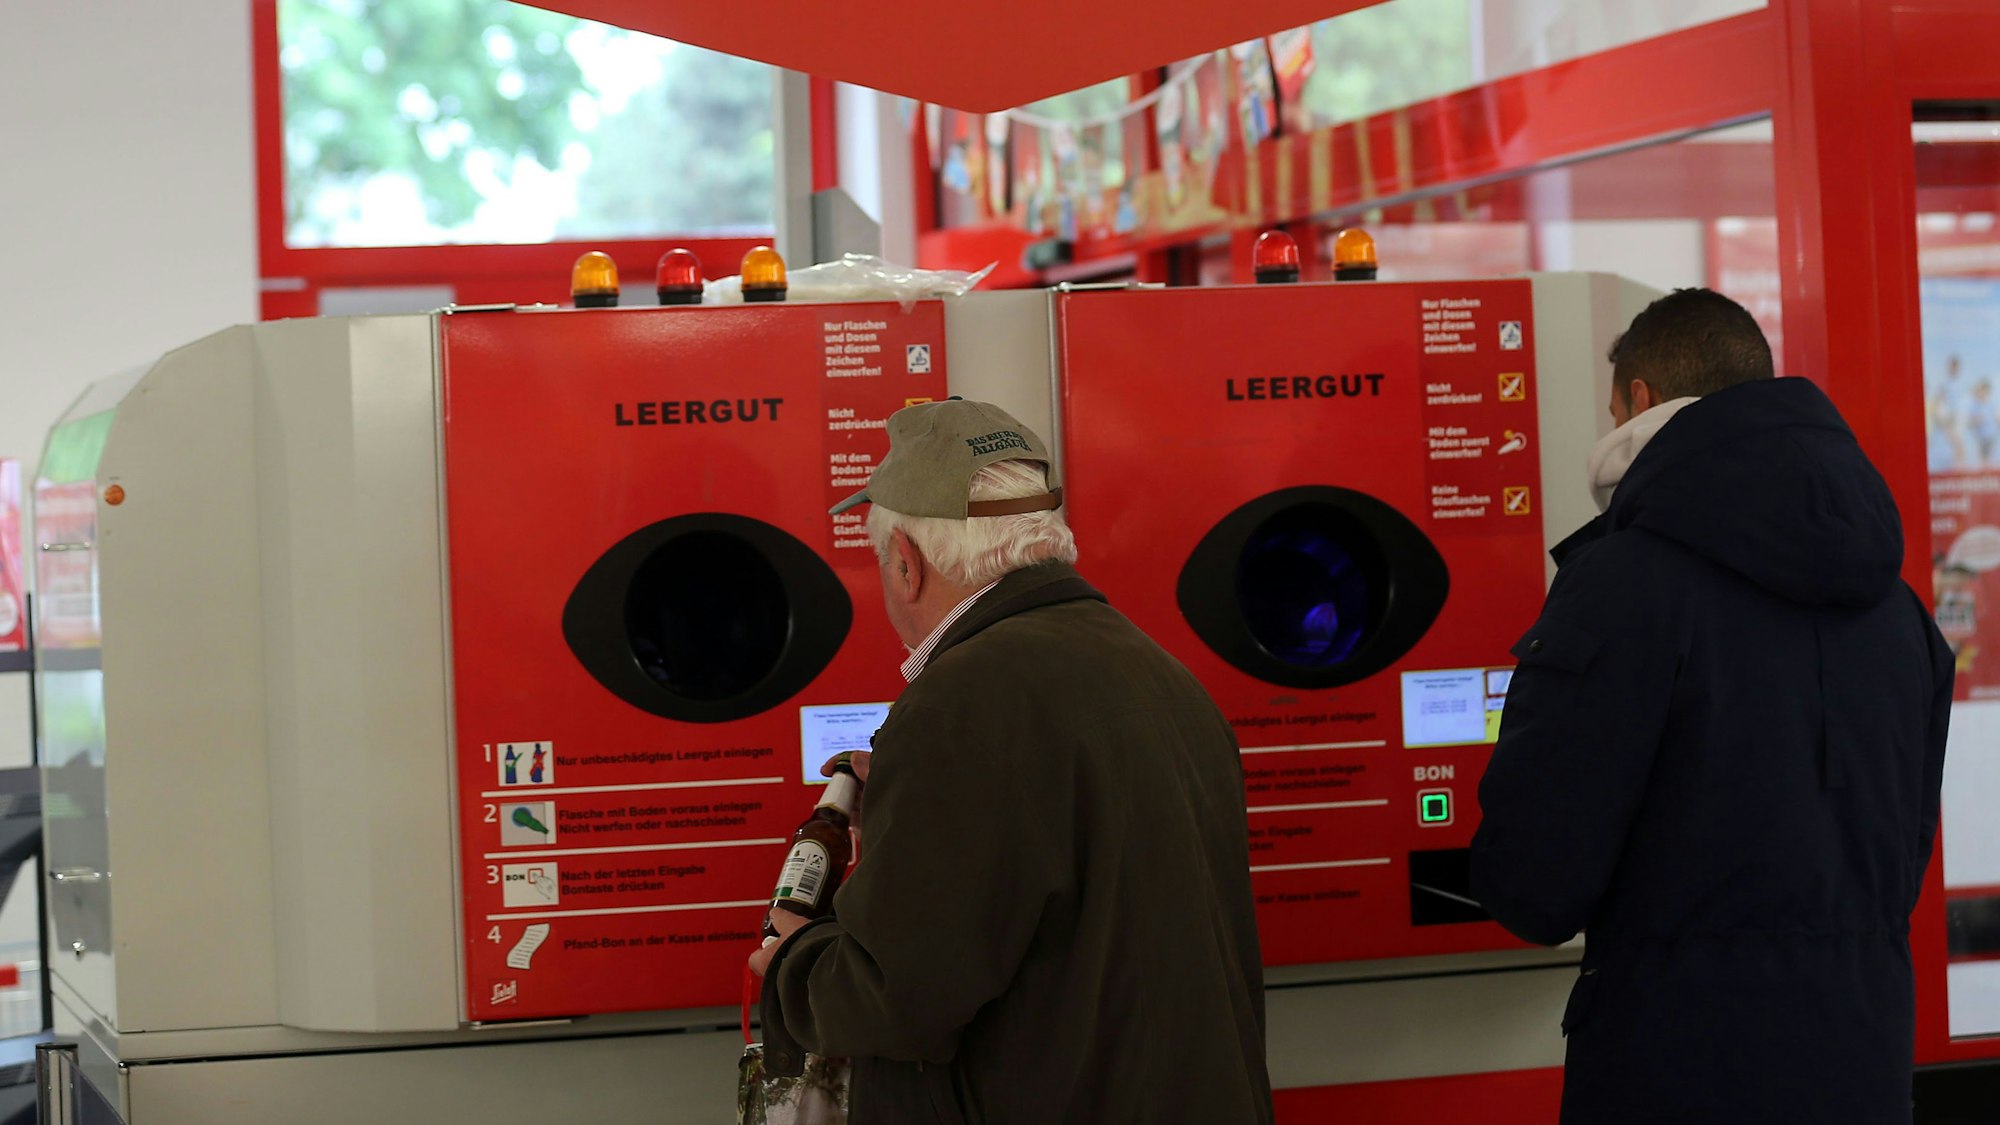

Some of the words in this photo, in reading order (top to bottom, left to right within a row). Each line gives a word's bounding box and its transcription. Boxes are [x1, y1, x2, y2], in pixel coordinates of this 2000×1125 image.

[1440, 298, 1481, 309] Flaschen
[824, 321, 843, 331] Nur
[844, 320, 887, 331] Flaschen
[825, 332, 844, 343] und
[846, 332, 877, 342] Dosen
[825, 344, 843, 354] mit
[844, 343, 881, 353] diesem
[826, 356, 865, 366] Zeichen
[826, 366, 882, 378] einwerfen!
[1227, 374, 1385, 401] LEERGUT
[615, 398, 784, 426] LEERGUT
[828, 408, 855, 418] Nicht
[966, 436, 987, 447] DAS
[986, 430, 1013, 442] BIER
[830, 453, 847, 463] Mit
[848, 452, 871, 463] dem
[831, 465, 863, 475] Boden
[833, 513, 862, 523] Keine
[1285, 713, 1328, 725] Leergut
[483, 744, 491, 762] 1
[557, 756, 576, 766] Nur
[581, 752, 673, 766] unbeschädigtes
[677, 750, 721, 762] Leergut
[724, 747, 773, 759] einlegen
[1413, 765, 1455, 782] BON
[484, 804, 497, 823] 2
[559, 809, 604, 820] Flasche
[608, 808, 625, 818] mit
[630, 806, 667, 817] Boden
[671, 805, 708, 815] voraus
[713, 801, 762, 813] einlegen
[559, 824, 590, 835] Nicht
[593, 822, 632, 832] werfen
[636, 820, 662, 830] oder
[665, 816, 746, 829] nachschieben
[486, 865, 499, 884] 3
[561, 871, 591, 881] Nach
[595, 869, 613, 879] der
[617, 868, 655, 878] letzten
[659, 865, 705, 878] Eingabe
[562, 883, 613, 895] Bontaste
[617, 881, 664, 893] drücken
[487, 926, 502, 943] 4
[564, 937, 626, 949] Pfand-Bon
[629, 937, 643, 946] an
[646, 935, 665, 945] der
[669, 933, 706, 944] Kasse
[707, 931, 757, 943] einlösen
